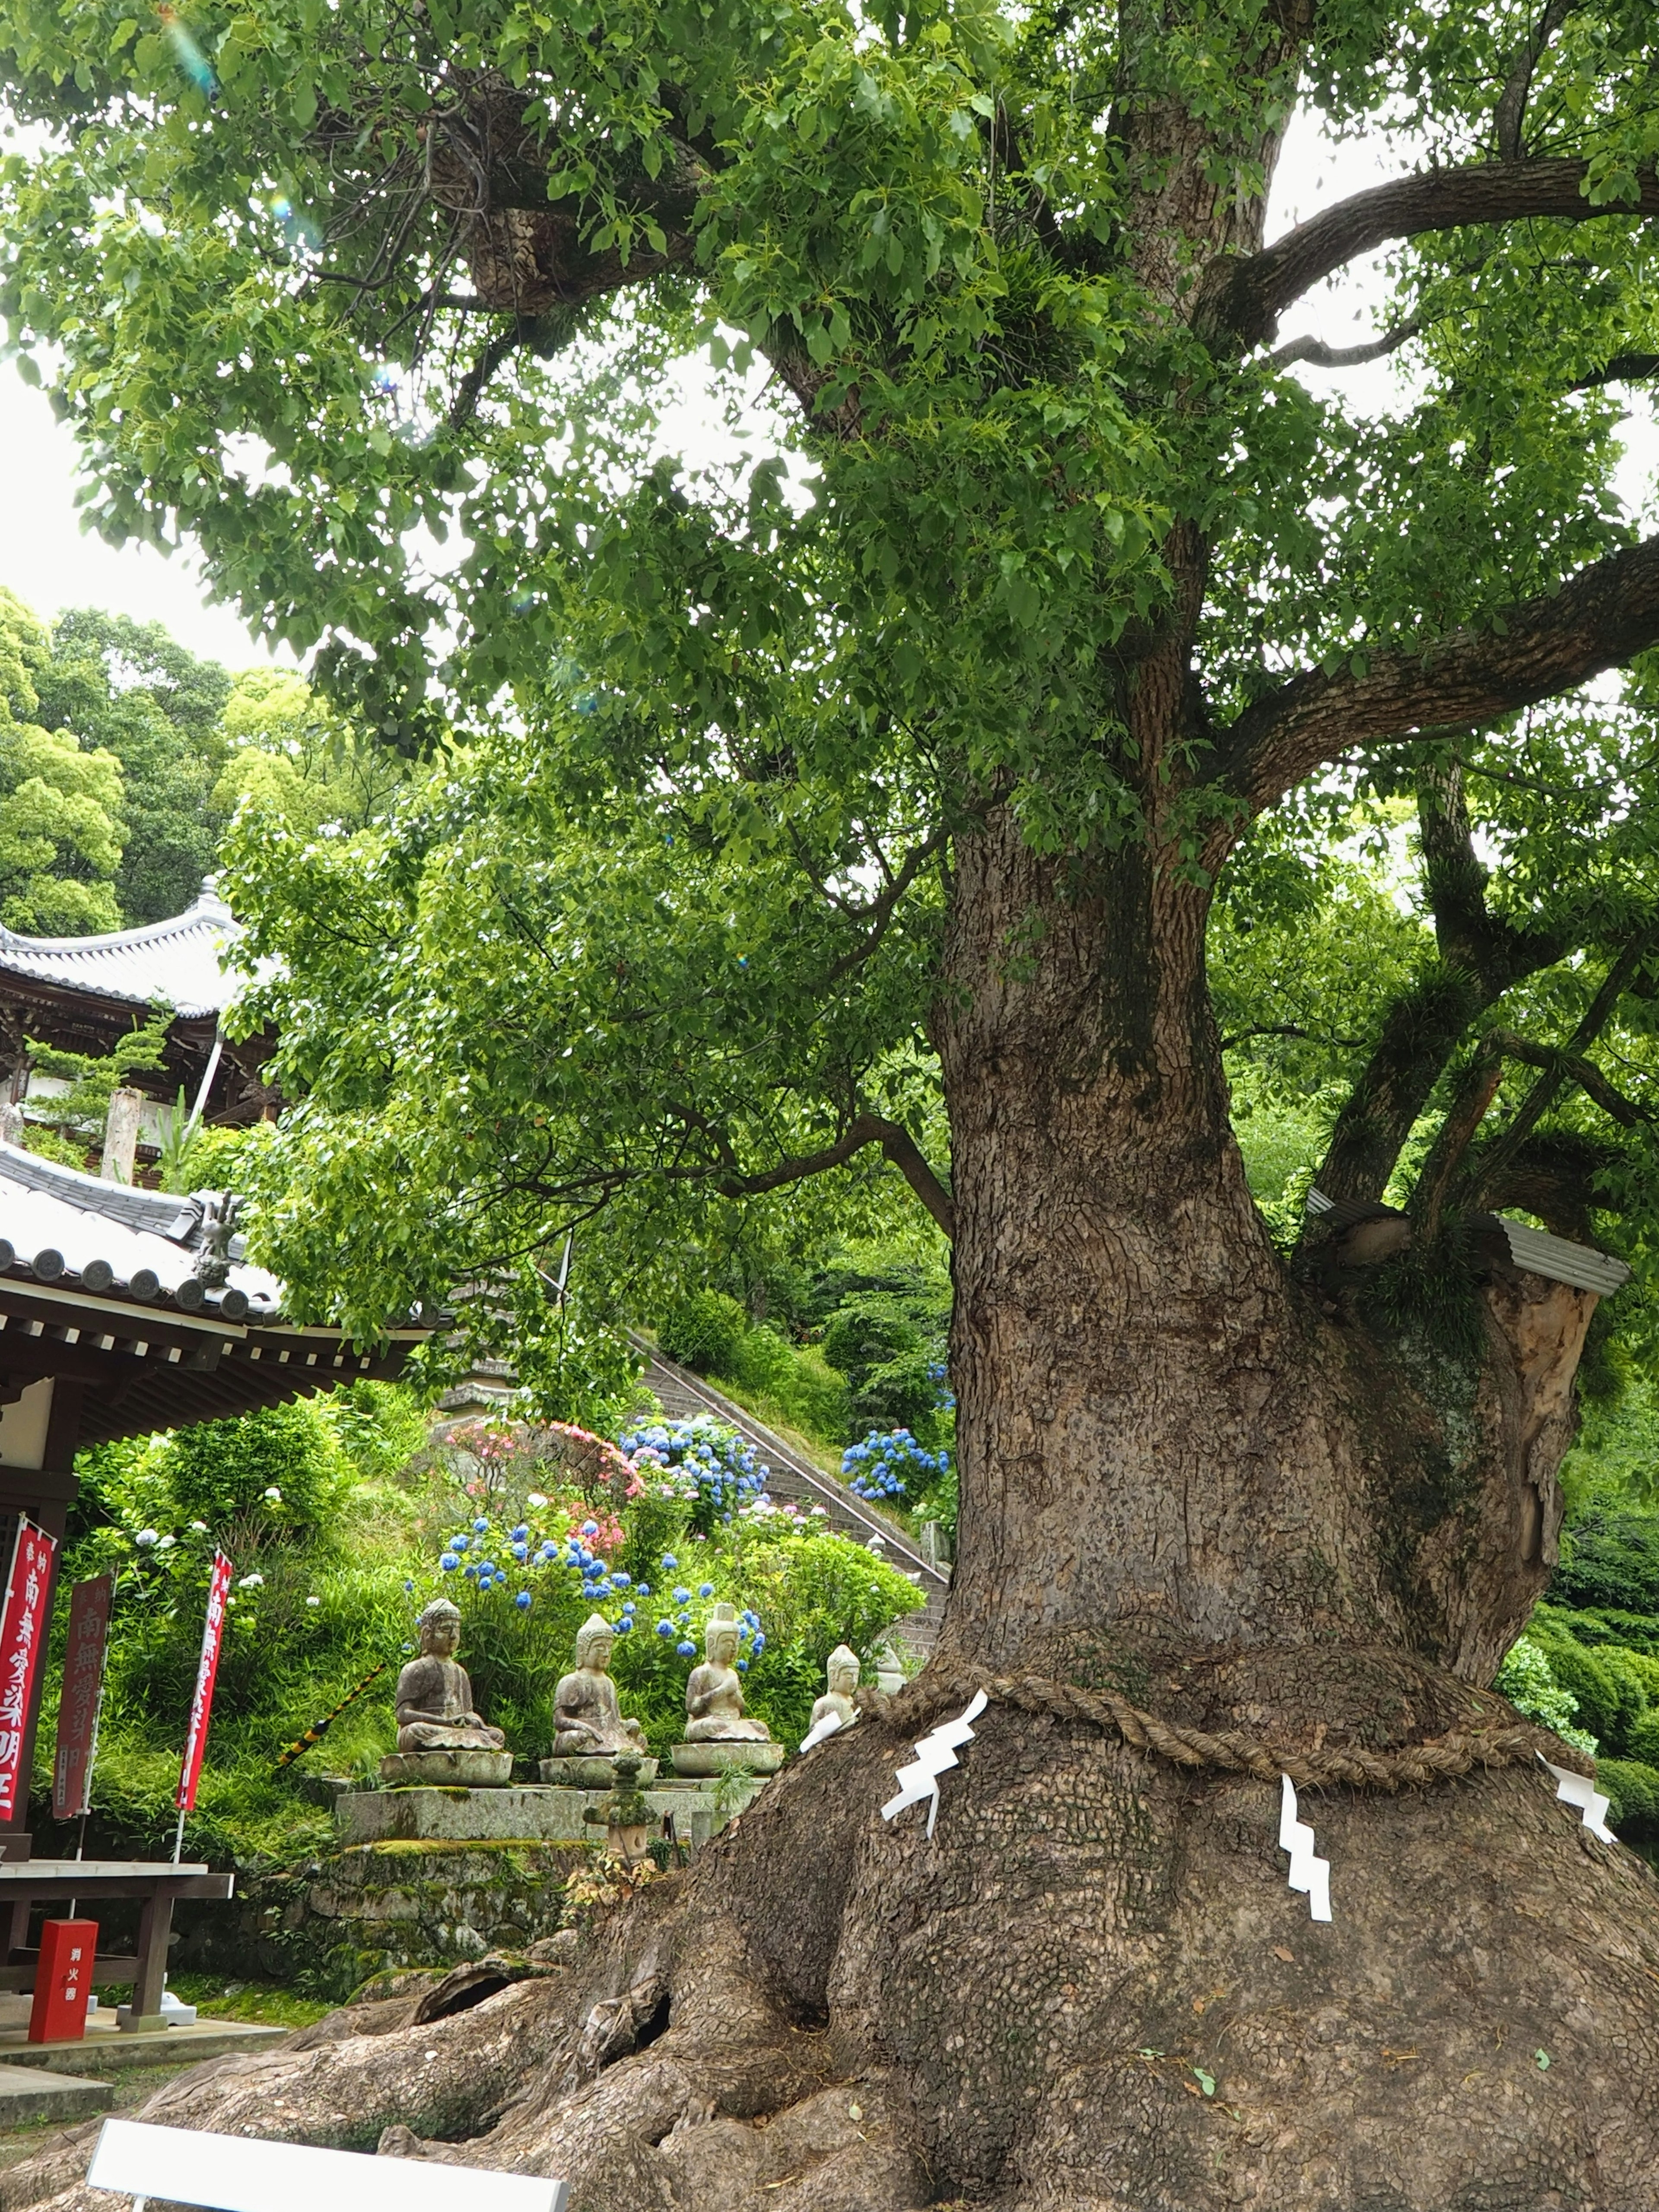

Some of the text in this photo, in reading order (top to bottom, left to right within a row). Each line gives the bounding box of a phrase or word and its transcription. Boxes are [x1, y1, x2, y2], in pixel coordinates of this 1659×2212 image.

[26, 1541, 47, 1574] 奉納
[65, 1947, 82, 2001] 消火器
